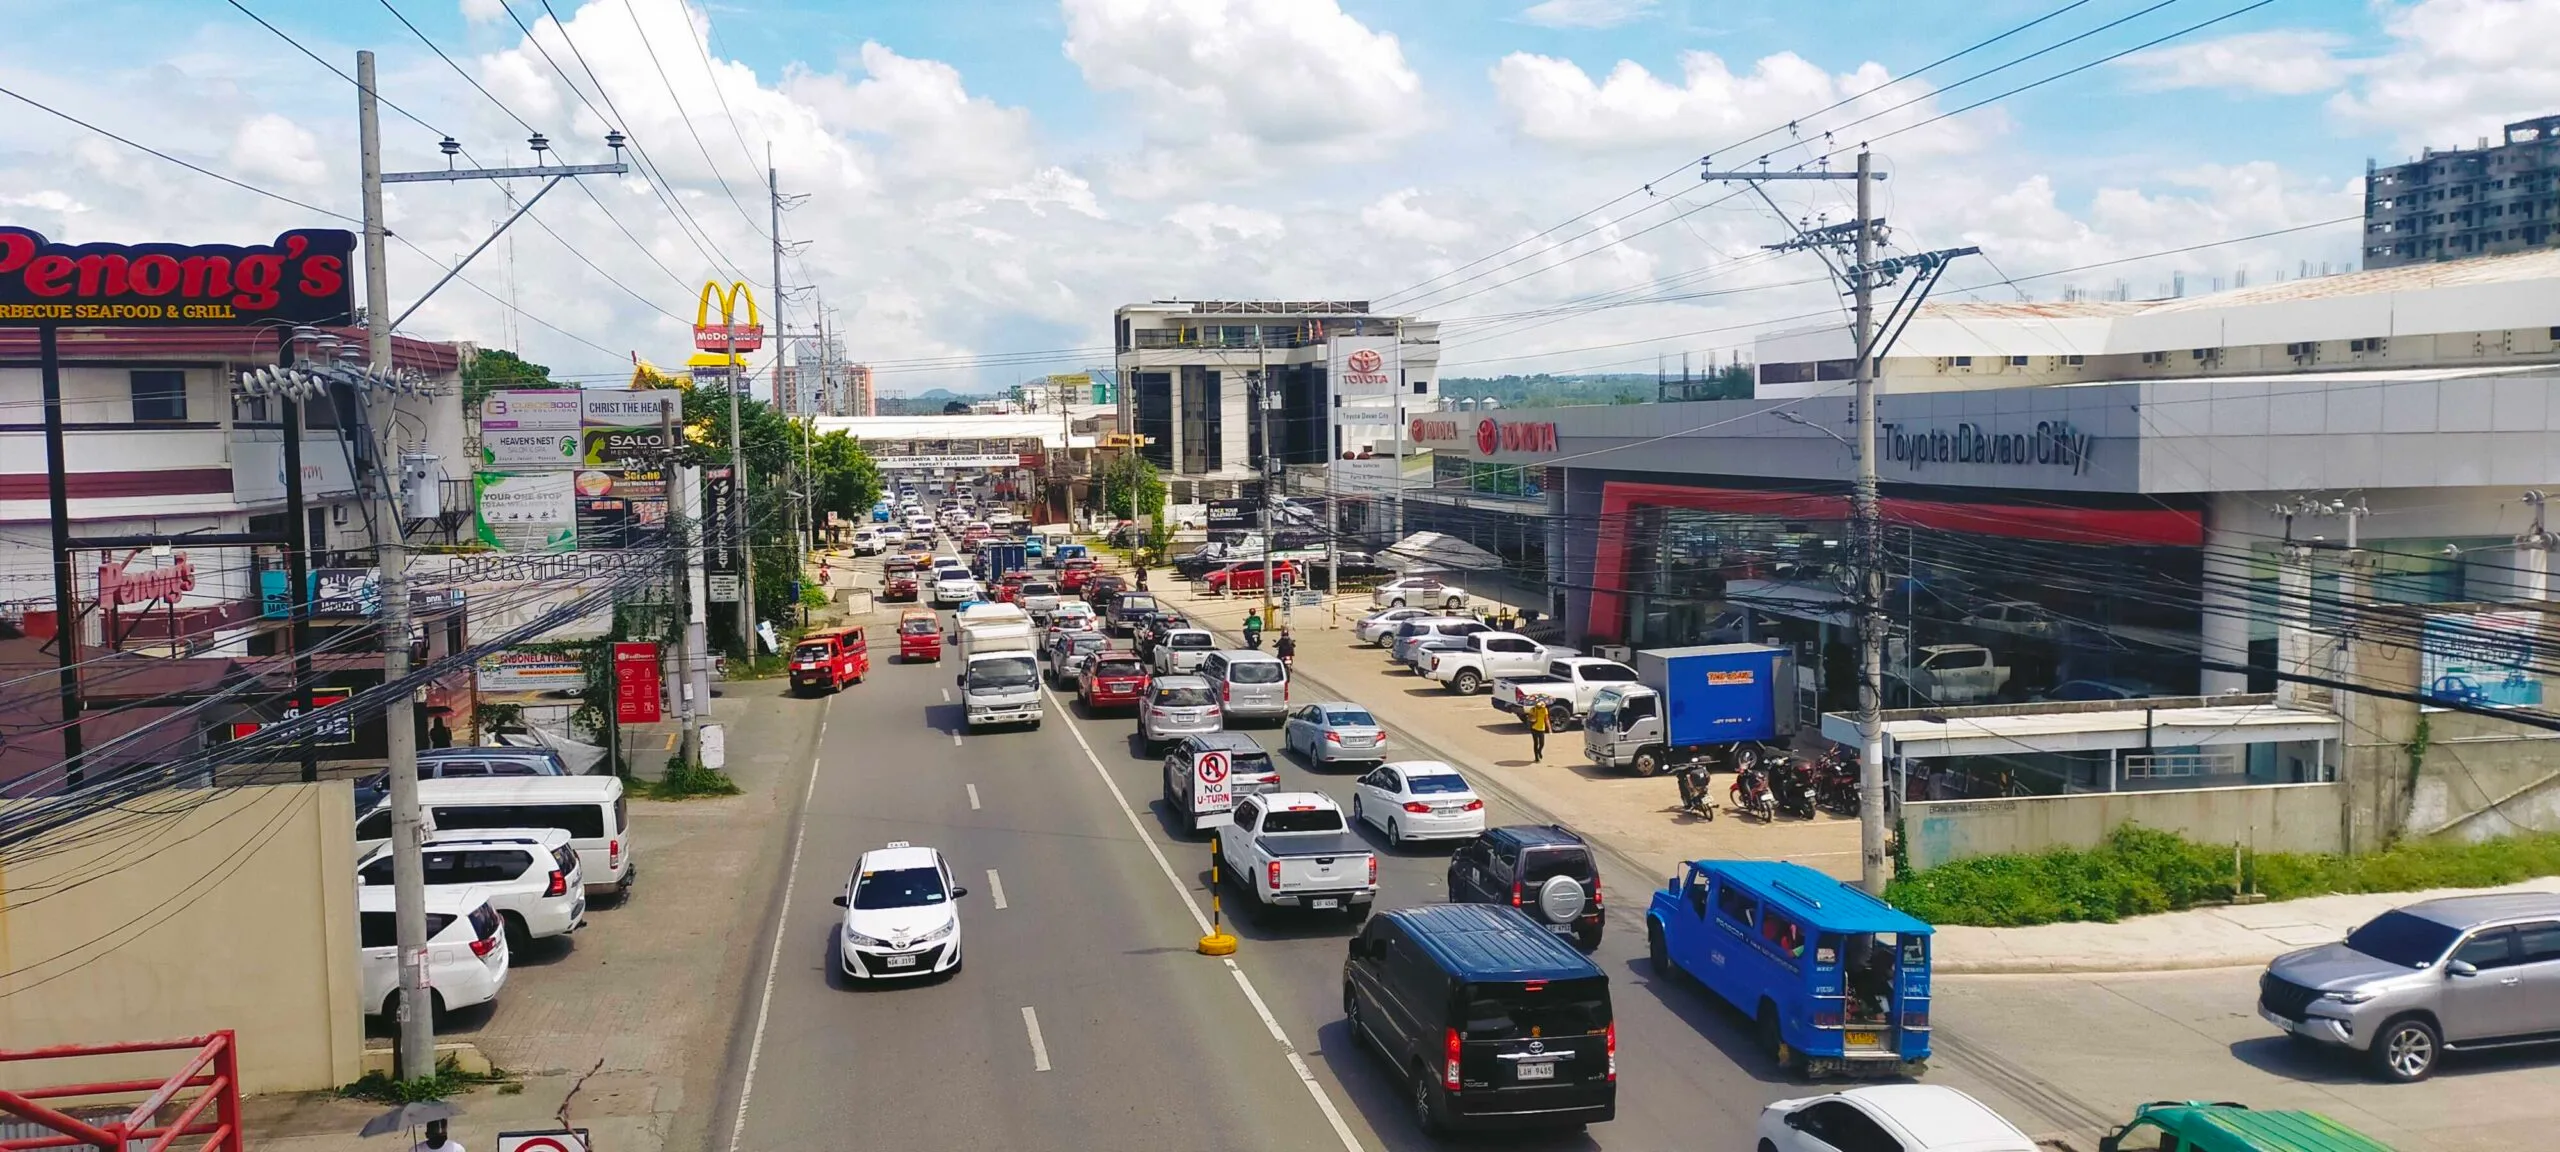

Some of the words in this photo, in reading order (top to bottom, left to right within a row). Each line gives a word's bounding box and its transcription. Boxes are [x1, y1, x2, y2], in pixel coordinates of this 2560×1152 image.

[76, 304, 162, 319] SEAFOOD
[166, 305, 179, 318] &
[183, 304, 236, 319] GRILL
[1343, 375, 1389, 384] TOYOTA
[589, 402, 620, 414] CHRIST
[622, 402, 640, 413] THE
[641, 402, 675, 413] HEALR
[500, 436, 535, 446] HEAVEN'S
[537, 436, 555, 445] NEST
[1502, 421, 1558, 452] TOYOTA
[1882, 423, 1950, 472] Toyota
[1958, 423, 2028, 465] Davao
[2036, 420, 2087, 476] City
[484, 493, 511, 501] YOUR
[537, 492, 562, 500] STOP
[449, 556, 525, 583] DUSK
[526, 554, 587, 581] TILL
[99, 552, 195, 611] Penong's
[1204, 784, 1223, 793] NO
[1197, 793, 1230, 805] U-TURN
[1518, 1068, 1532, 1077] LAH
